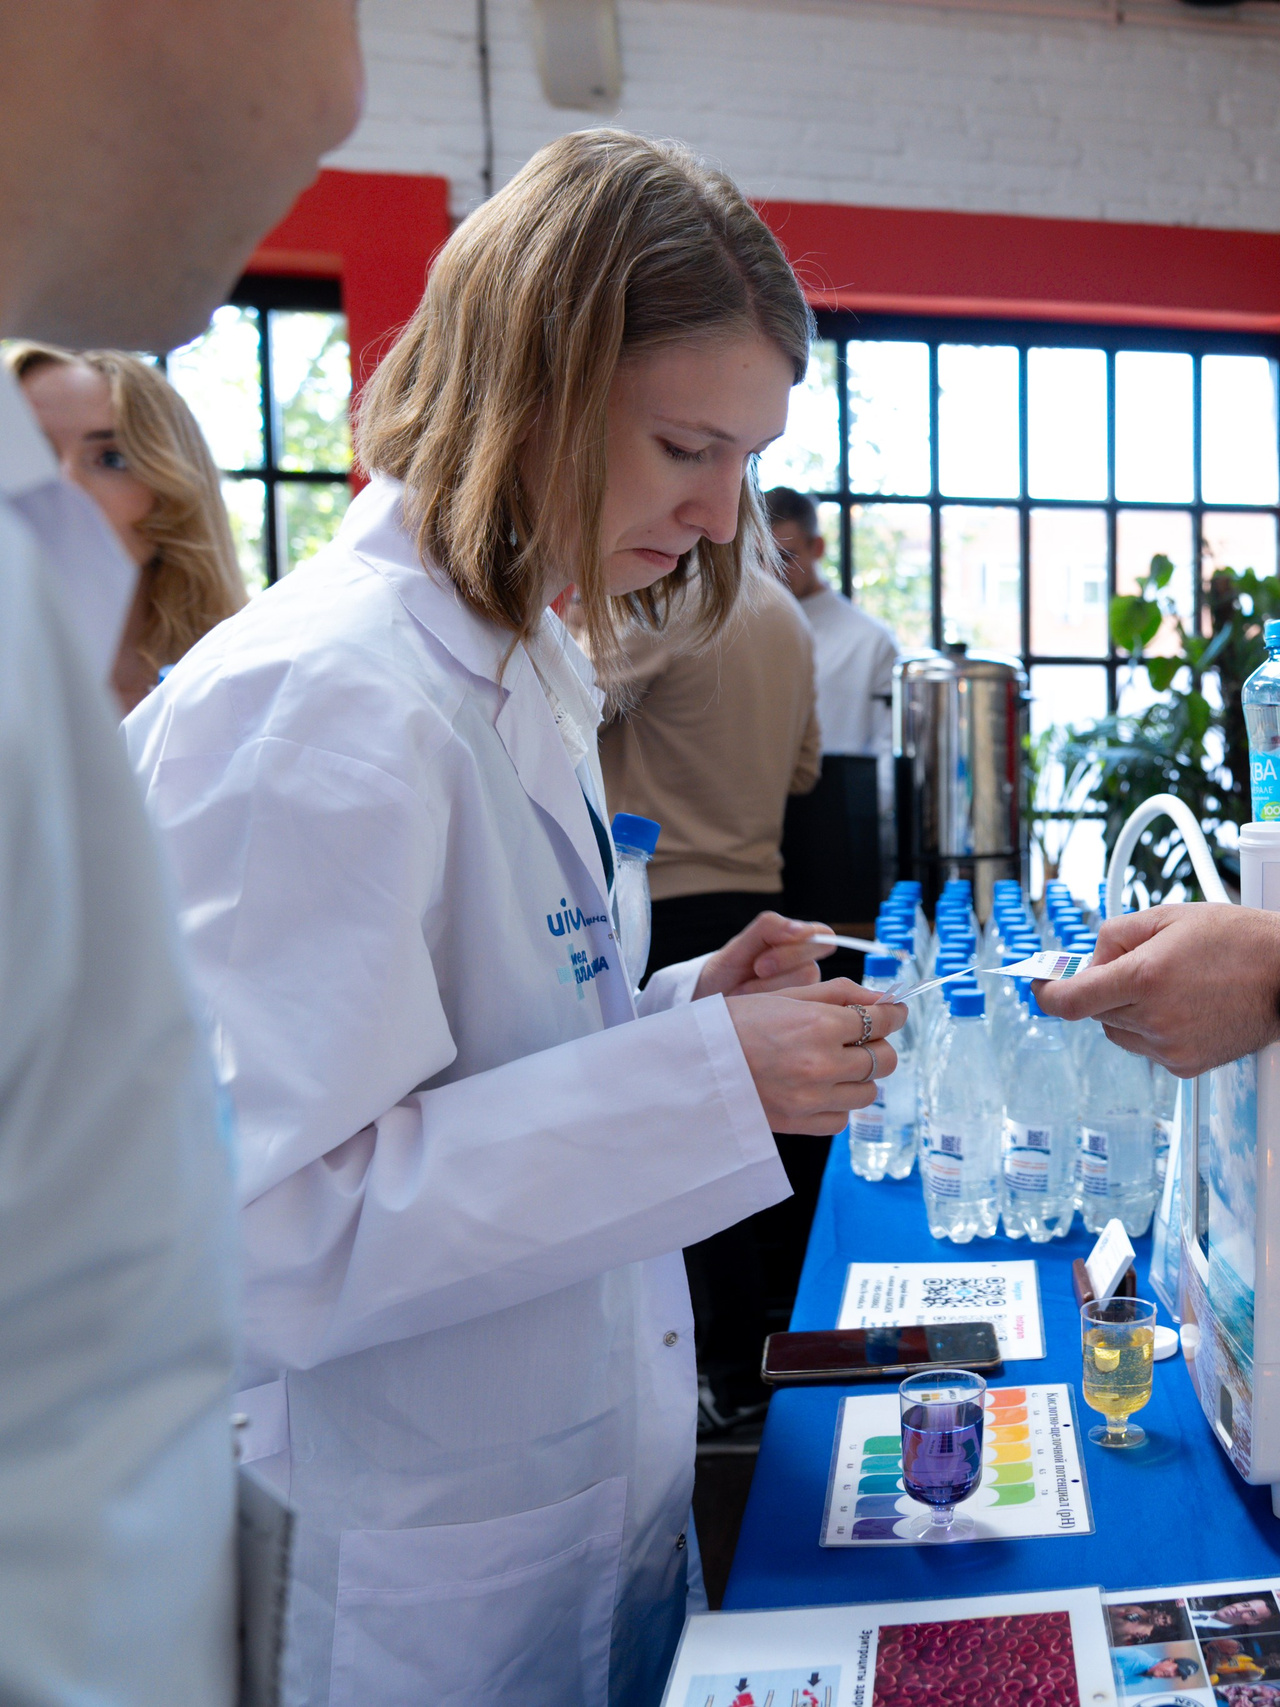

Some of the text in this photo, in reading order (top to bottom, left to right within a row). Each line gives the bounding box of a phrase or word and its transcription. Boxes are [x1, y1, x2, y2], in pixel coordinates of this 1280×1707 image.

[1014, 1314, 1025, 1339] Instagram
[1046, 1392, 1076, 1529] Кислотно-щелочной потенциал (pH)
[852, 1629, 873, 1707] Эритроциты здор
